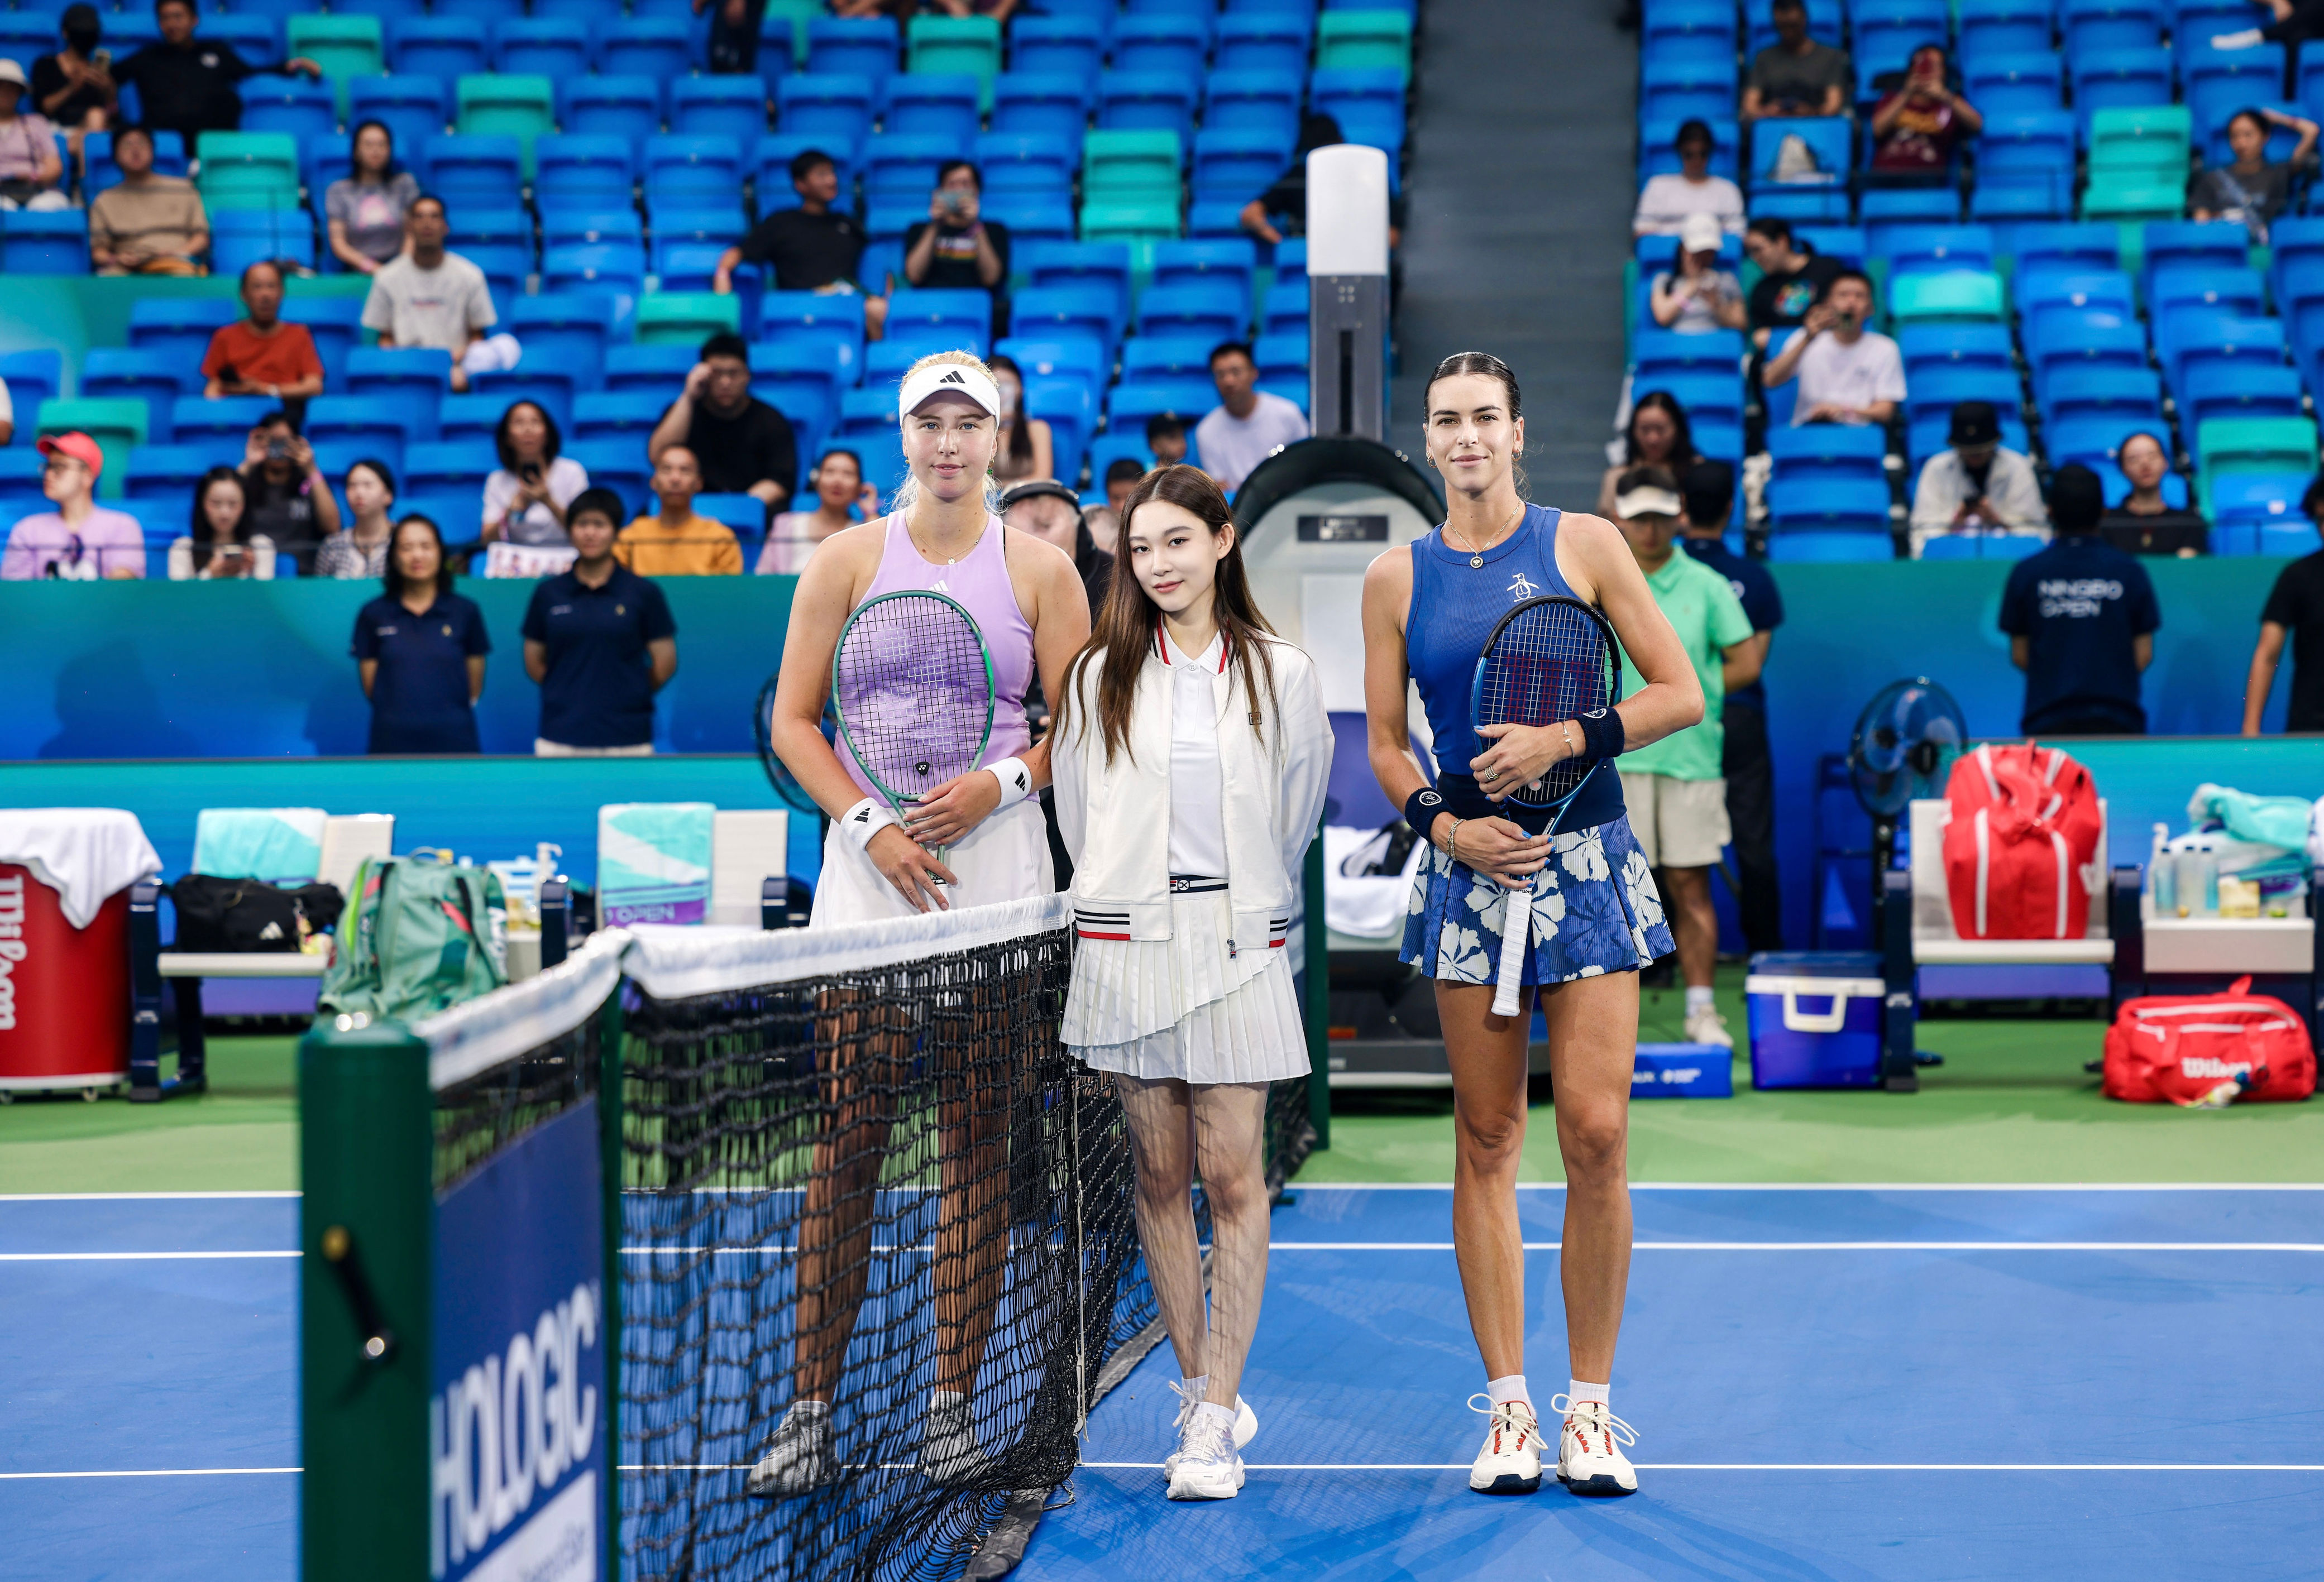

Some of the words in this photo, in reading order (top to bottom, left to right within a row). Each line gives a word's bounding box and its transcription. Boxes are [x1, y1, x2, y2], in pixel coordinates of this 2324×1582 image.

[2038, 579, 2124, 600] NINGBO
[2039, 598, 2102, 618] OPEN
[615, 903, 676, 923] OPEN
[429, 1283, 596, 1581] HOLOGIC
